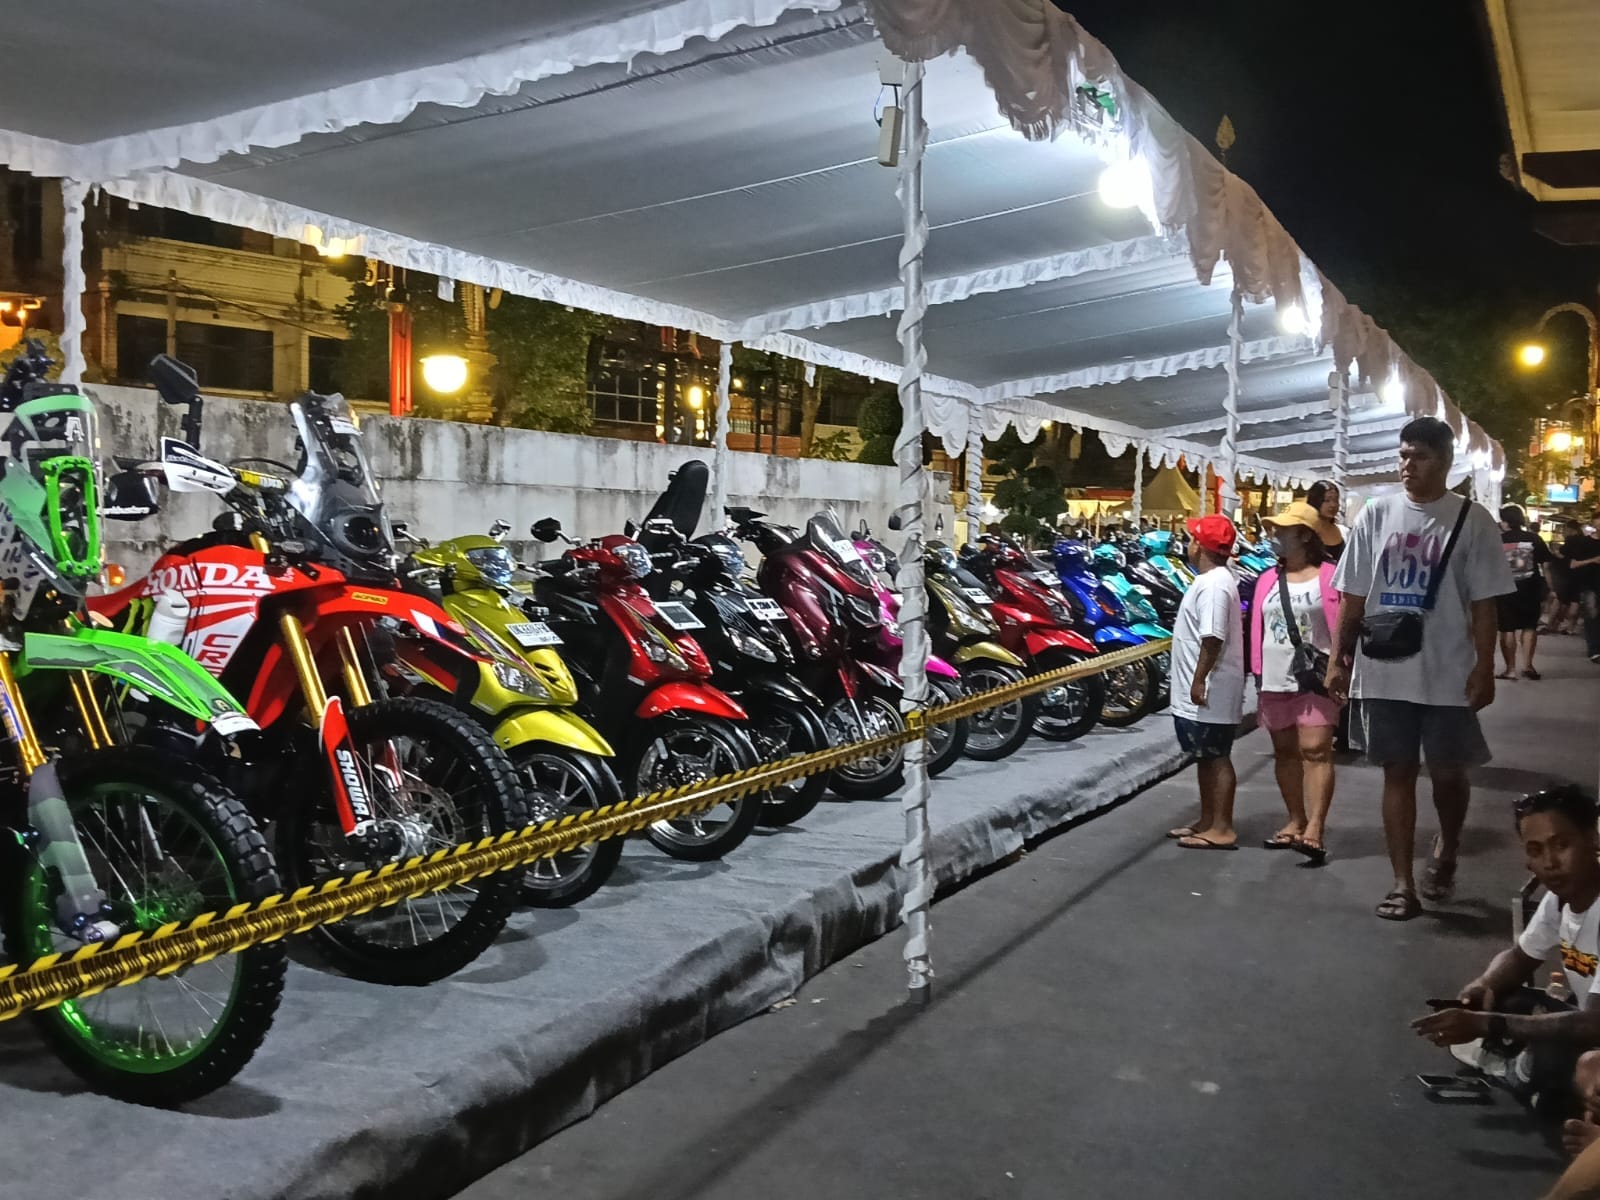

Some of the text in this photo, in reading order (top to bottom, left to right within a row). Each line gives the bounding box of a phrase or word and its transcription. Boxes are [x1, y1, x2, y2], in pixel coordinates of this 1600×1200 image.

[141, 561, 276, 596] HONDA
[1382, 531, 1441, 590] C59
[335, 748, 370, 816] SHOWA
